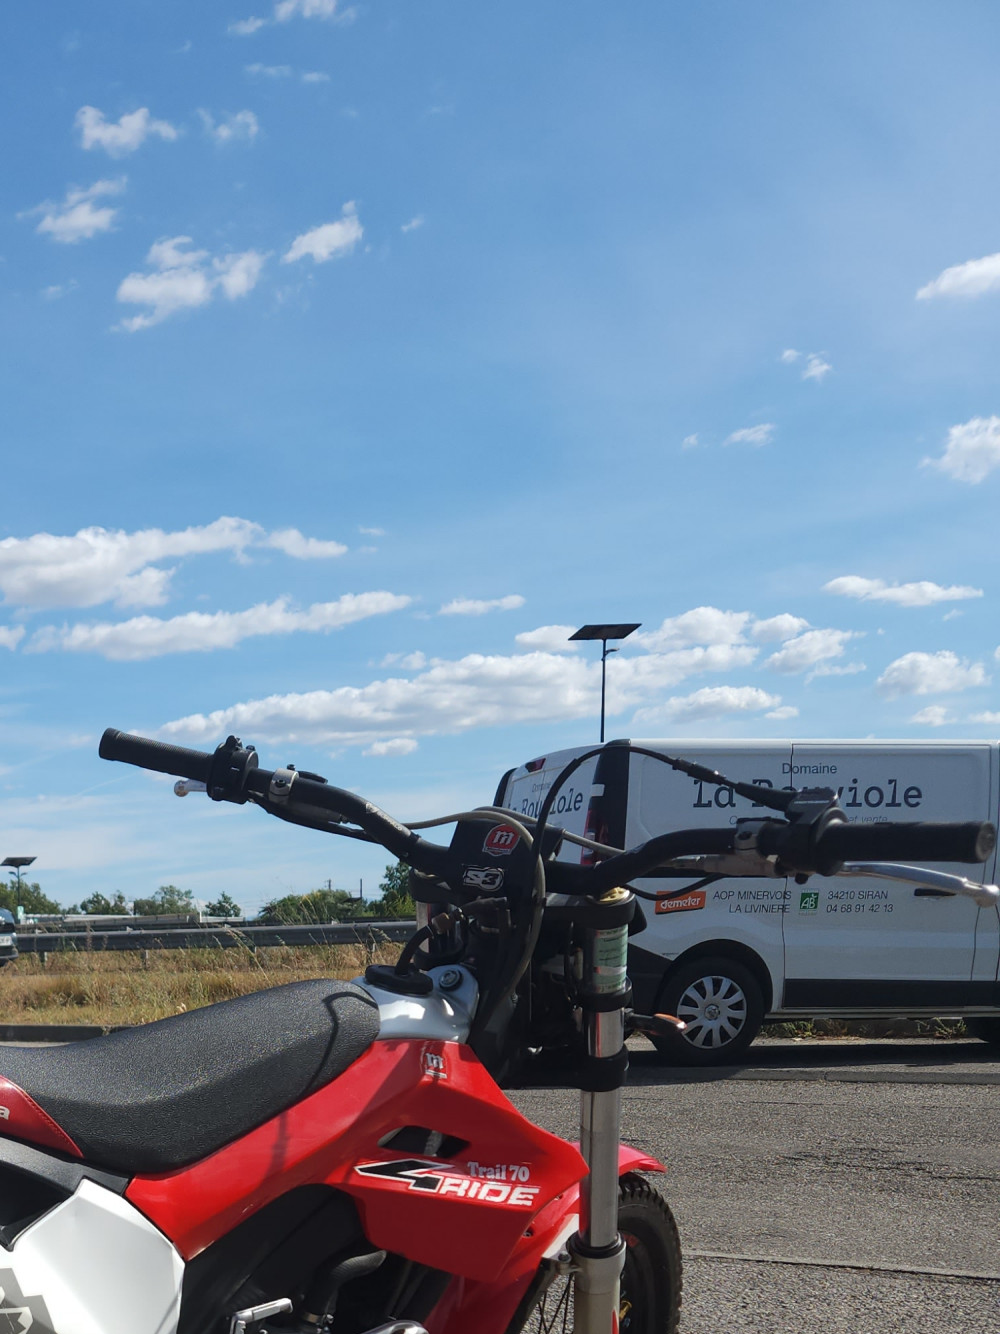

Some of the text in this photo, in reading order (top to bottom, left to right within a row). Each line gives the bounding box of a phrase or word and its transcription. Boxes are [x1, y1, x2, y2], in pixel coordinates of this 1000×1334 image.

[782, 763, 838, 775] Domaine
[693, 778, 736, 808] La
[713, 890, 735, 900] AOP
[737, 890, 792, 900] MINERVOIS
[828, 890, 856, 900] 34210
[858, 890, 888, 900] SIRAN
[660, 895, 701, 909] demeter
[728, 904, 742, 914] LA
[745, 904, 791, 914] LIVINIERE
[826, 904, 838, 914] 04
[840, 904, 852, 914] 68
[855, 904, 866, 914] 91
[869, 904, 881, 914] 42
[883, 904, 894, 914] 13
[467, 1161, 530, 1182] Trail 70
